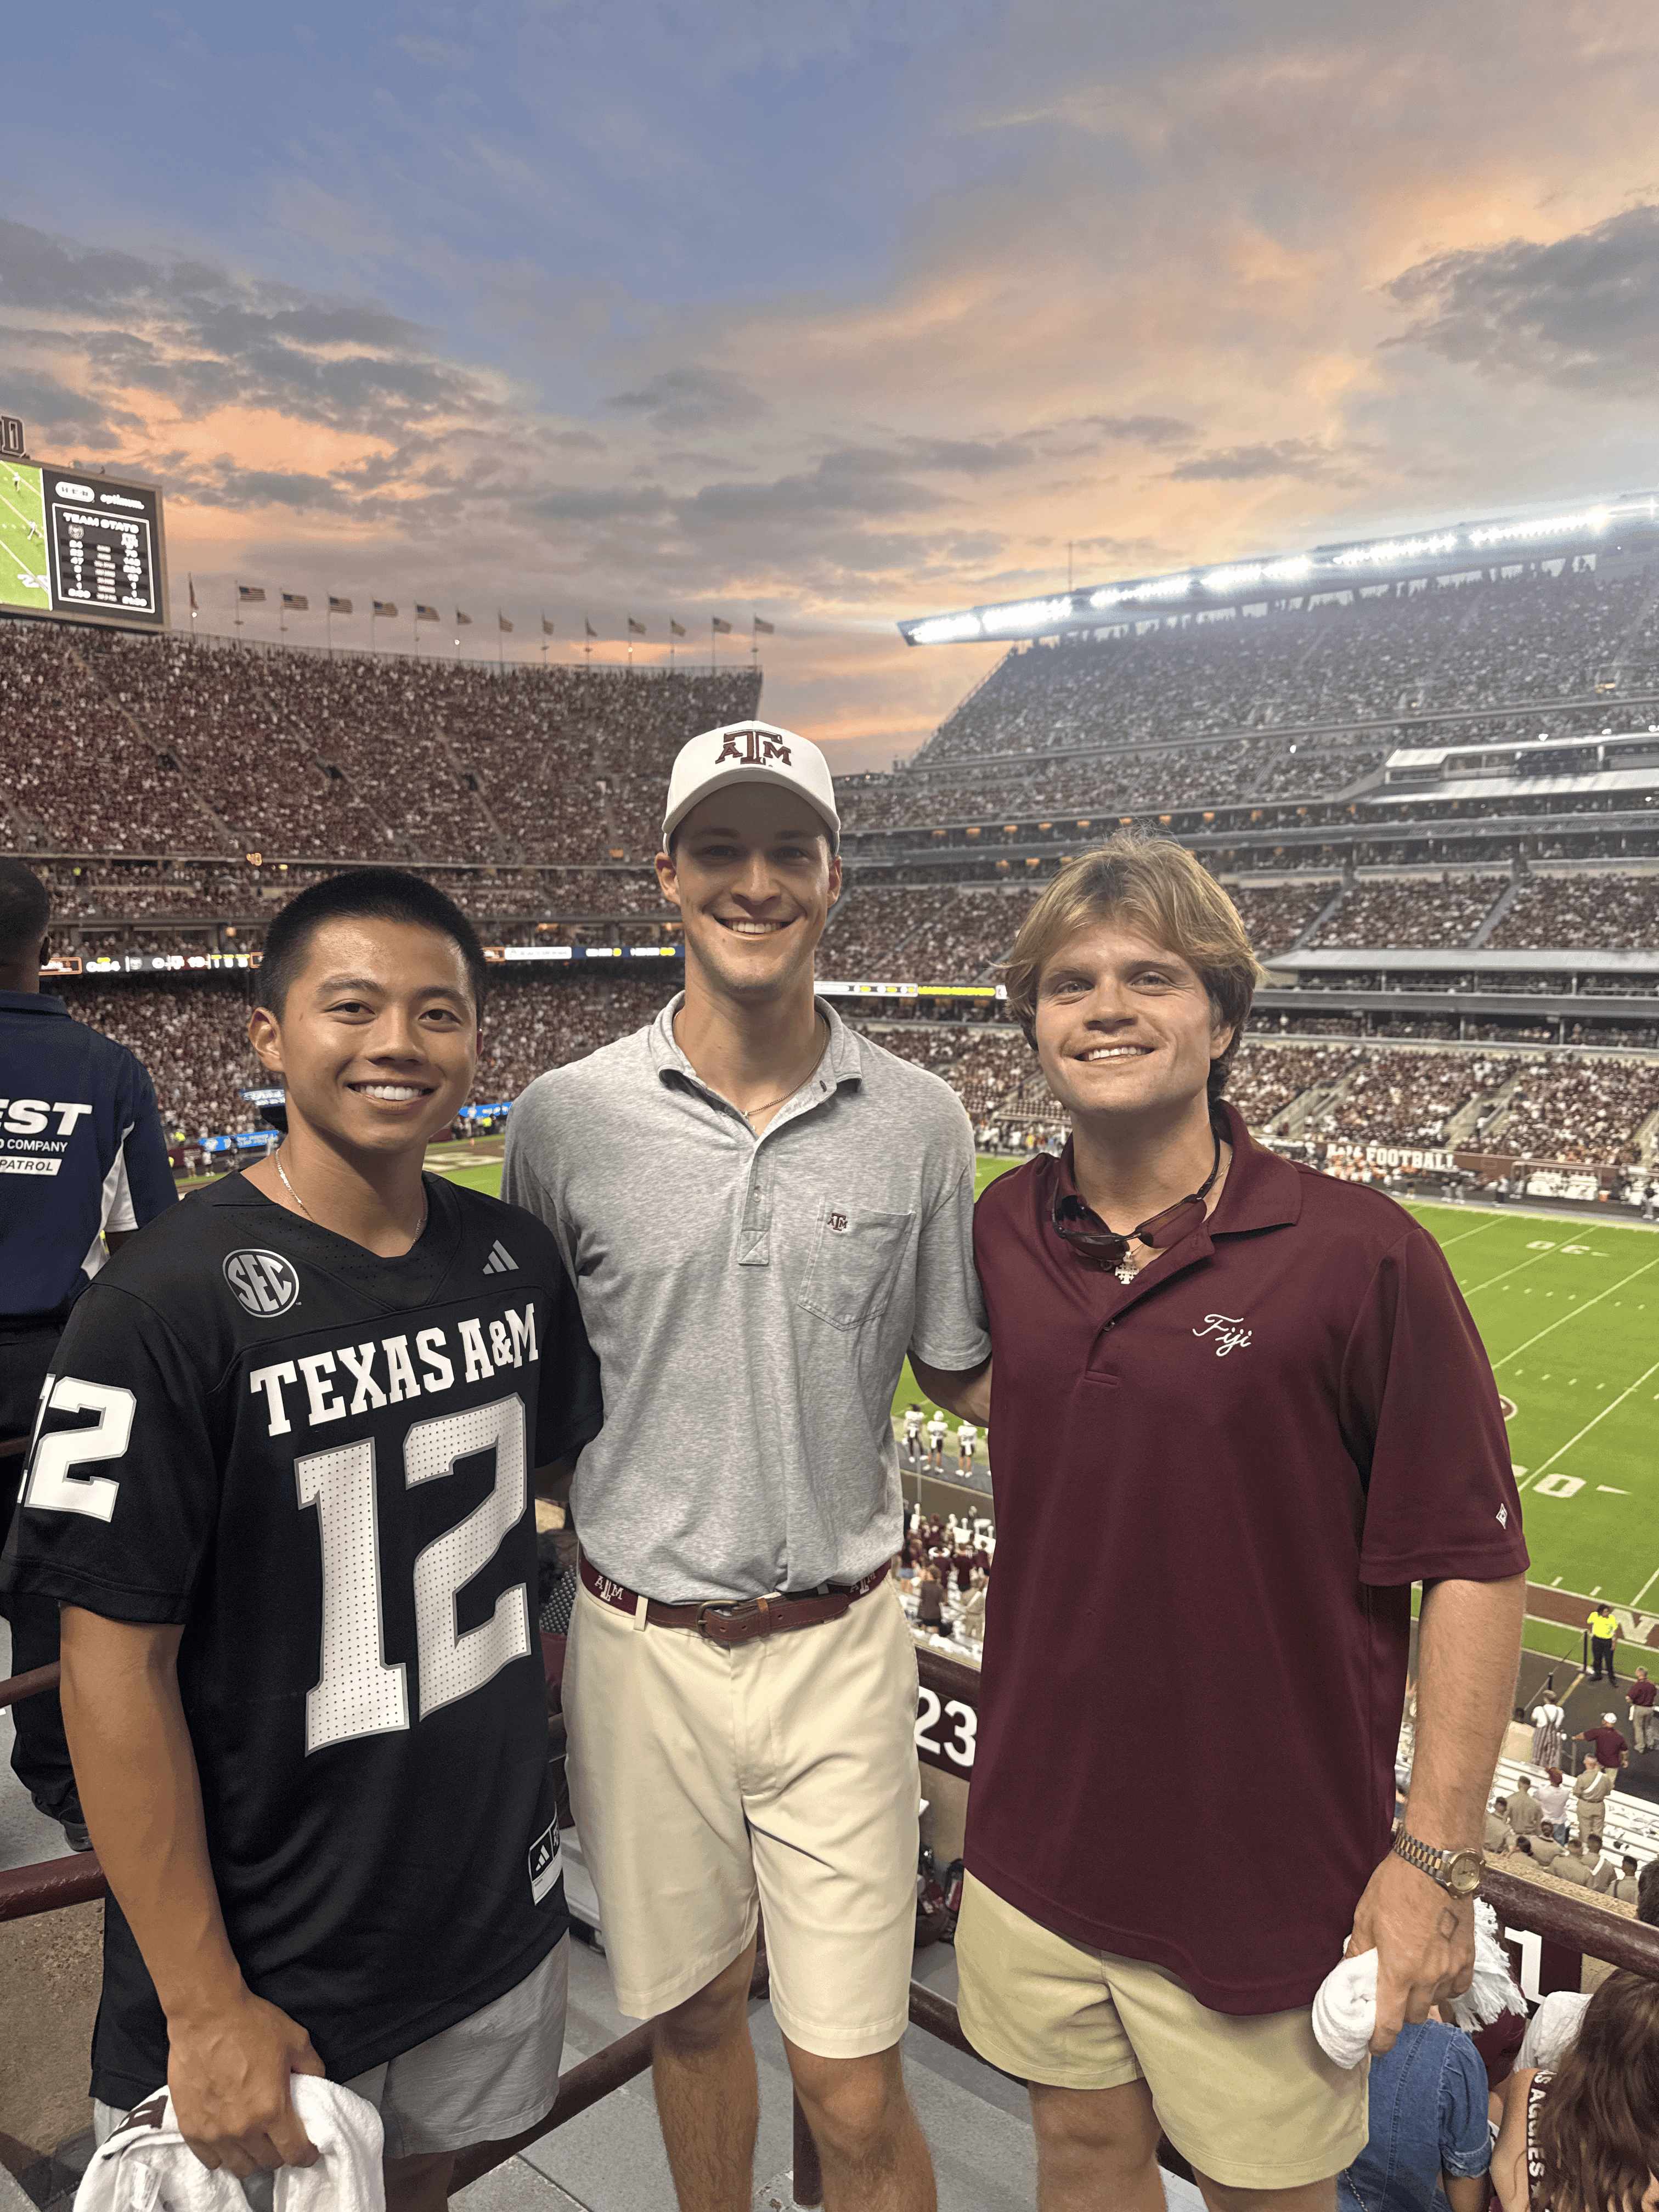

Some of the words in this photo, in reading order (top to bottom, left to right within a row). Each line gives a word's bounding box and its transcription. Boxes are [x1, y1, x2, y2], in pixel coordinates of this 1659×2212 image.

[63, 512, 99, 527] TEAM
[0, 1159, 54, 1172] PATROL
[7, 1138, 68, 1152] COMPANY
[1366, 1147, 1454, 1169] FOOTBALL
[228, 1254, 292, 1312] SEC
[1192, 1313, 1252, 1357] Fiji
[250, 1327, 455, 1437] TEXAS
[459, 1302, 540, 1384] A&M
[294, 1392, 532, 1757] 12
[915, 1685, 978, 1768] 23
